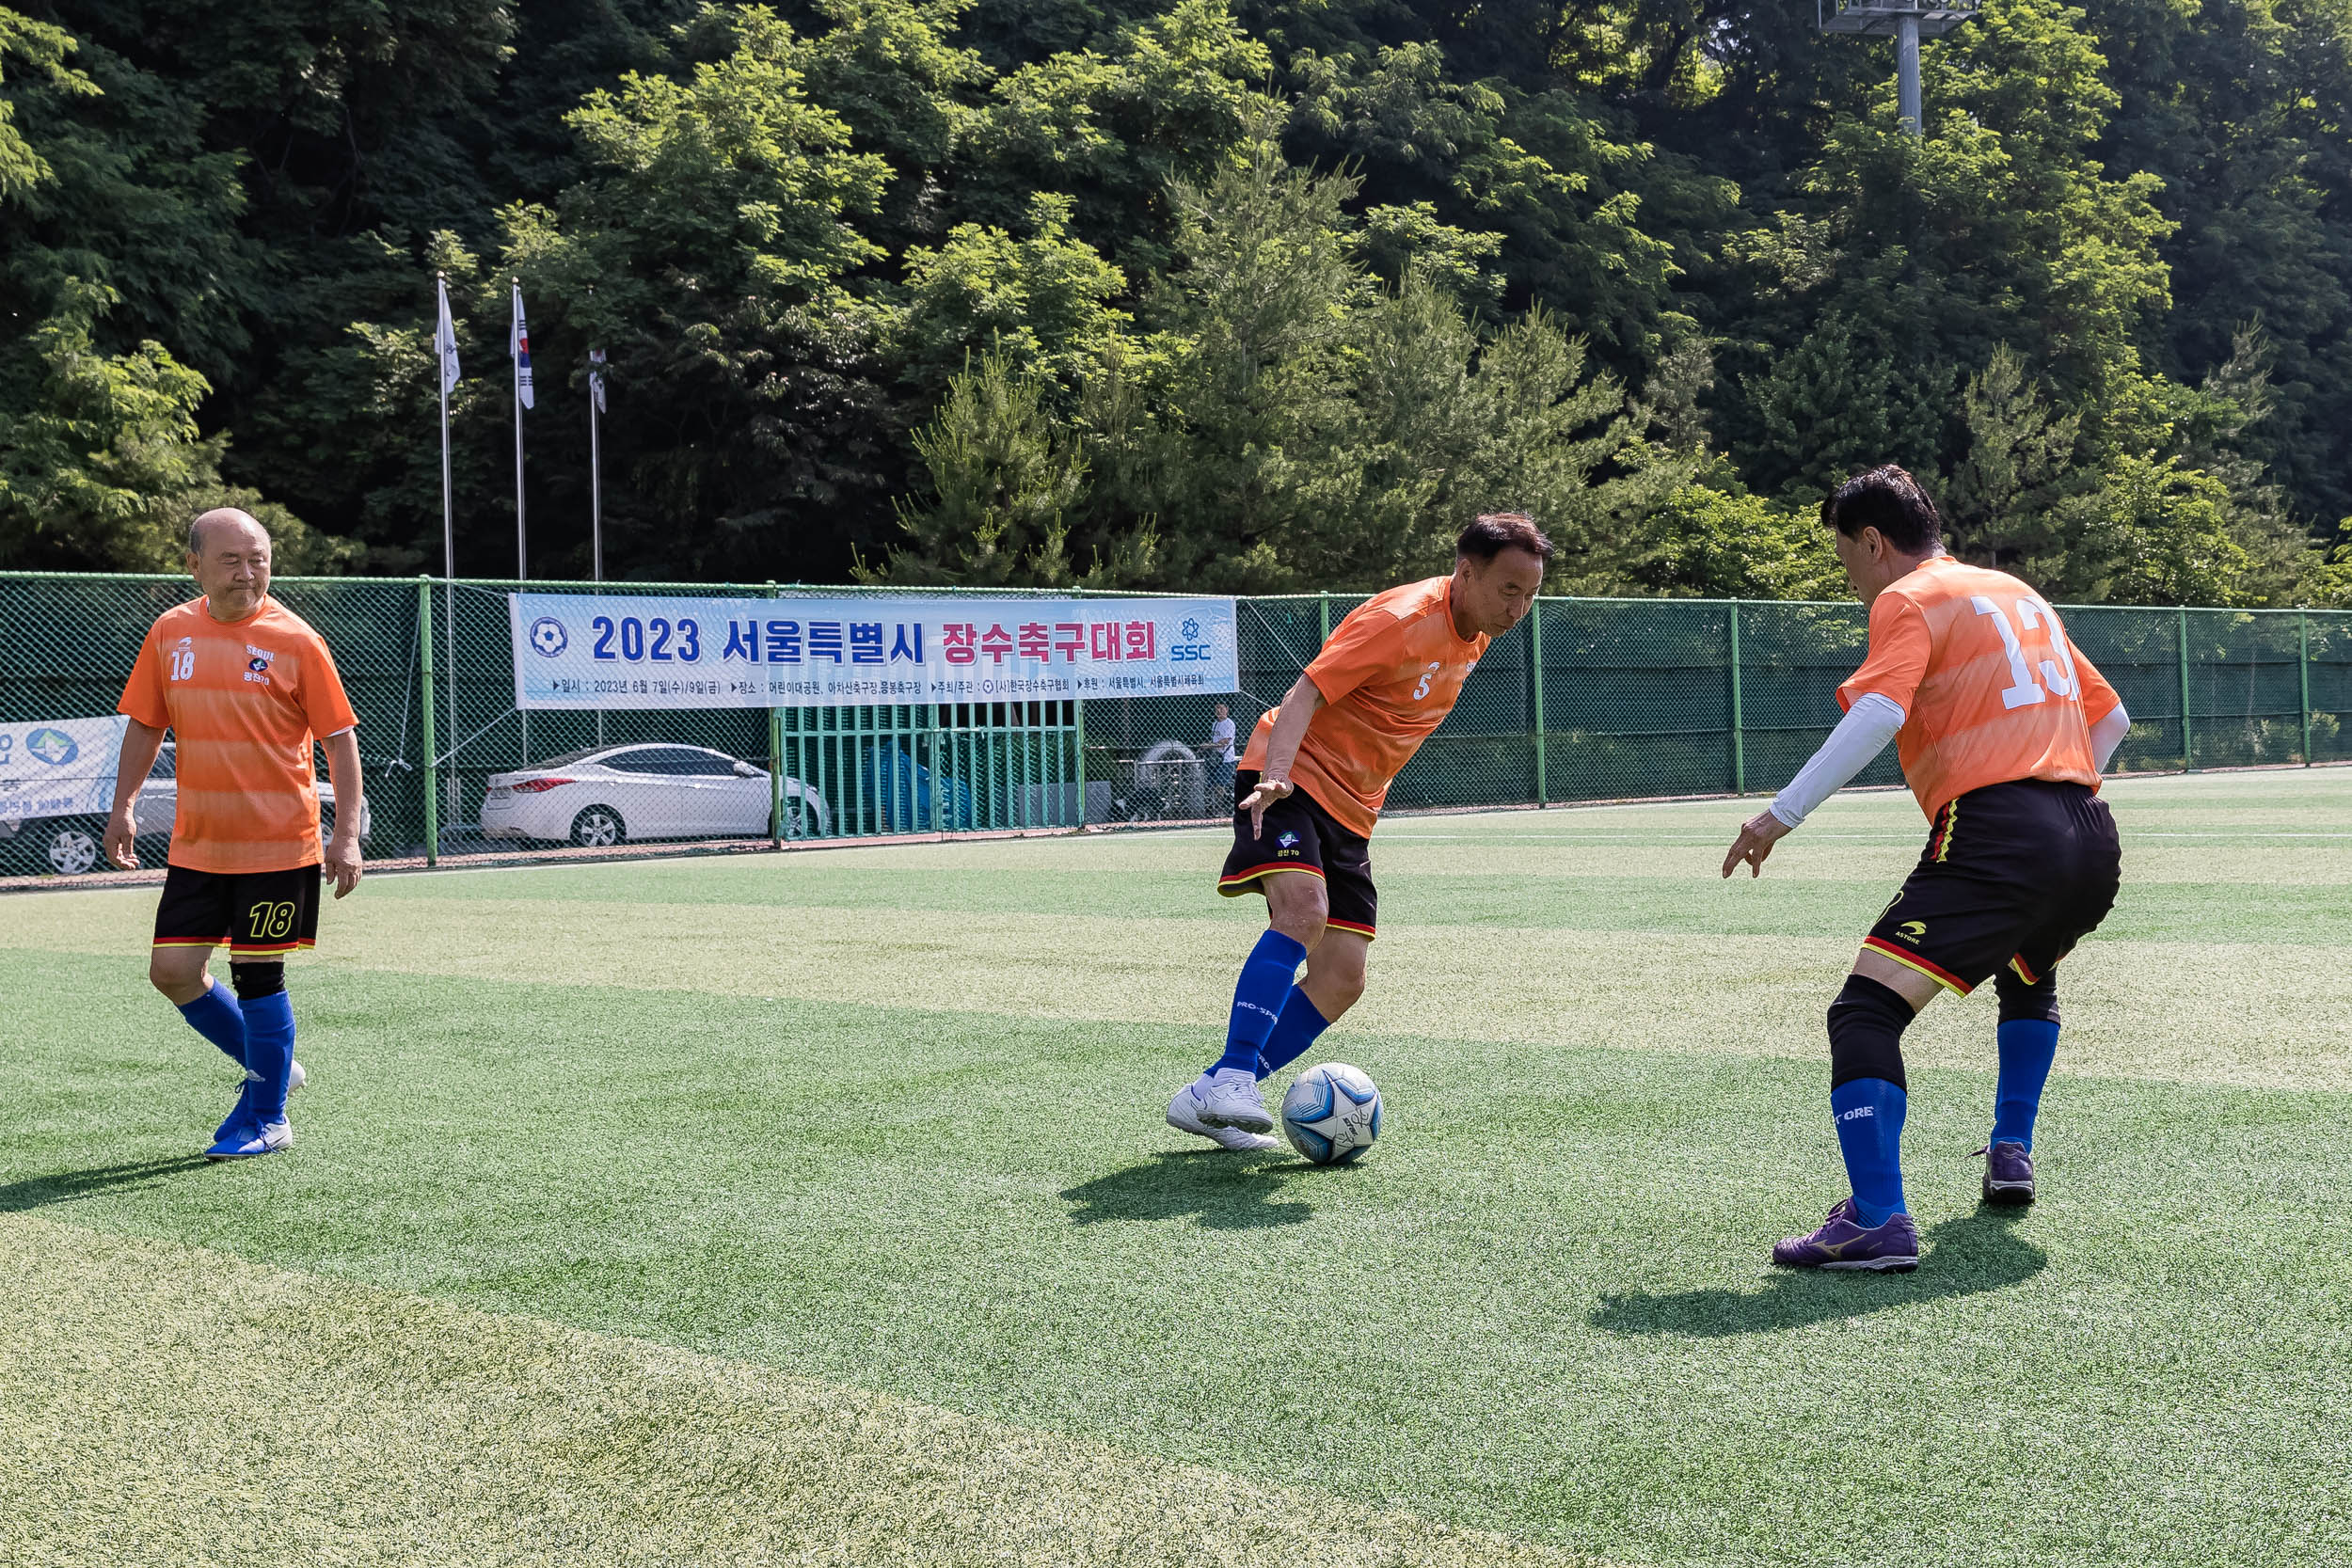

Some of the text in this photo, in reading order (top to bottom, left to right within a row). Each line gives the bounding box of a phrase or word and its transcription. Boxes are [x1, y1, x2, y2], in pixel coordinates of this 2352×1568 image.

[246, 644, 275, 662] SEOUL
[591, 616, 1156, 665] 2023 서울특별시 장수축구대회
[1171, 644, 1212, 661] SSC
[1970, 595, 2079, 710] 13
[170, 651, 196, 681] 18
[561, 679, 580, 693] 일시
[594, 679, 628, 694] 2023년
[632, 680, 648, 693] 6월
[652, 680, 722, 695] 7일(수)/9일(금)
[739, 681, 756, 694] 장소
[937, 680, 974, 694] 주최/주관
[1083, 677, 1099, 690] 후원
[1413, 673, 1432, 701] 5
[249, 901, 294, 938] 18
[1895, 931, 1921, 945] ASTORE
